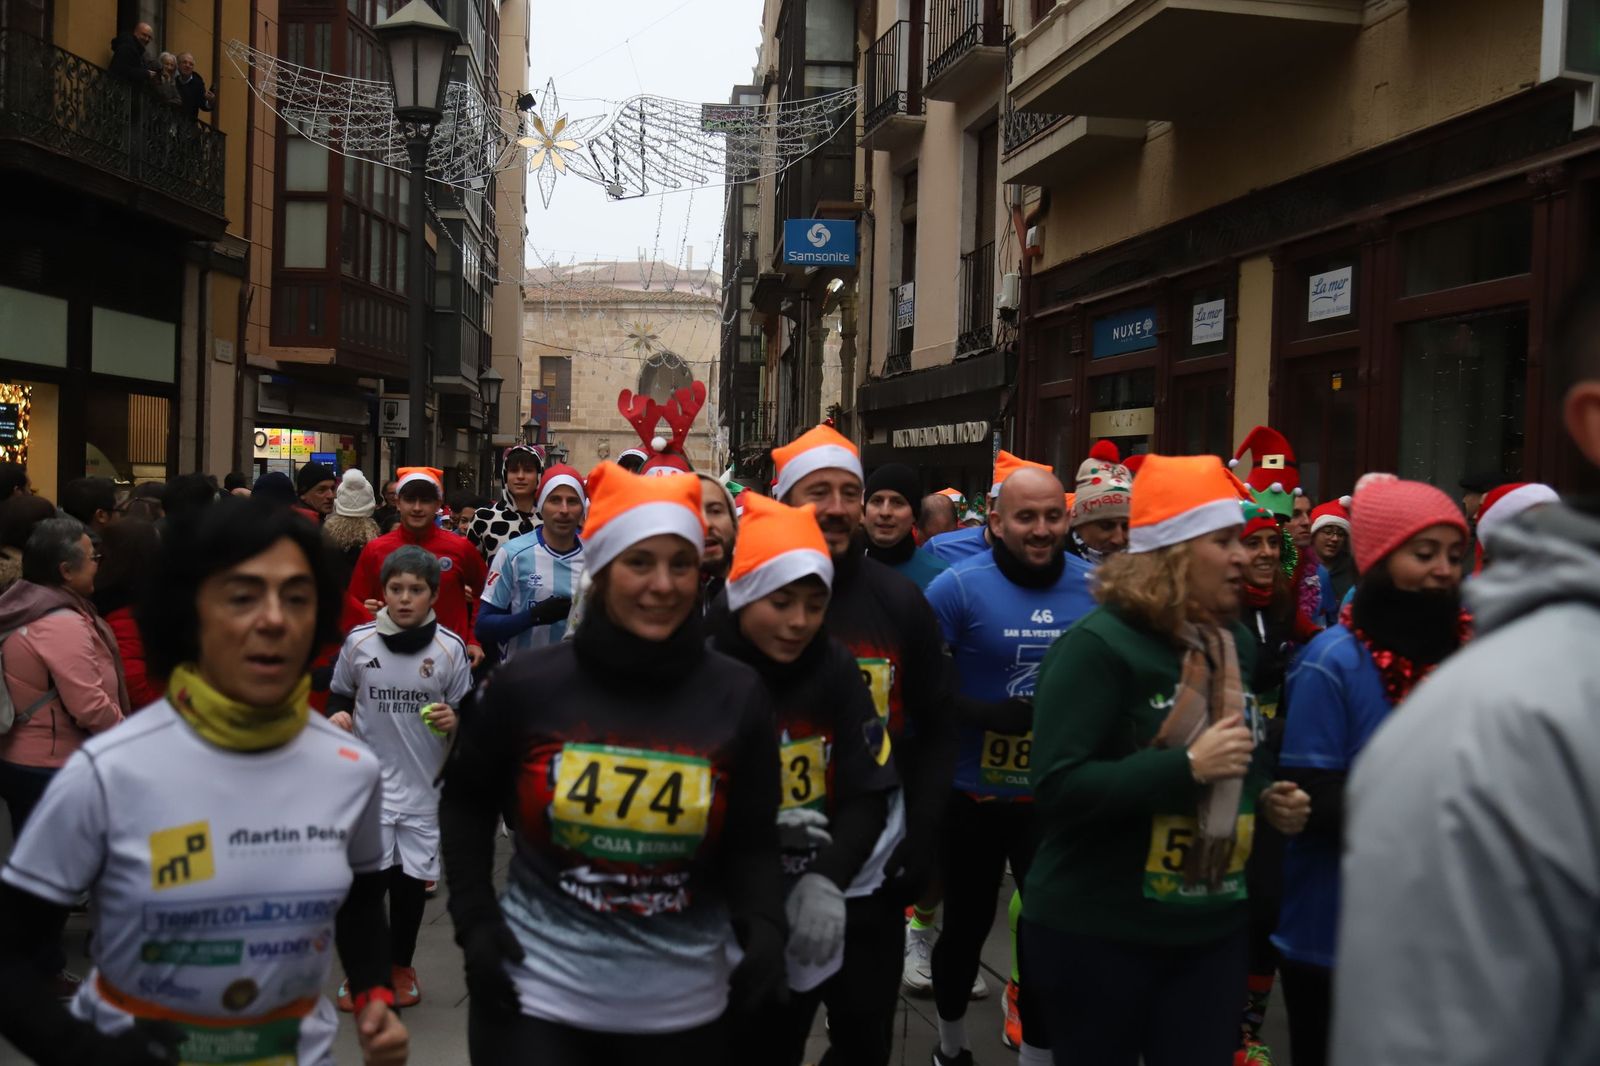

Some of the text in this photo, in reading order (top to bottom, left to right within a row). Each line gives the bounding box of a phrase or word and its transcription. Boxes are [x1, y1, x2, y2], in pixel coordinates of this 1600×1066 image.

[788, 251, 850, 262] Samsonite
[1312, 277, 1349, 296] La mer
[1195, 307, 1223, 322] La mer
[1112, 321, 1142, 340] NUXE
[956, 421, 988, 444] WORLD
[1030, 609, 1054, 624] 46
[1004, 629, 1019, 638] SAN
[1021, 629, 1061, 638] SILVESTRE
[369, 686, 430, 702] Emirates
[378, 702, 391, 713] FLY
[566, 760, 685, 826] 474
[592, 834, 633, 853] CAJA
